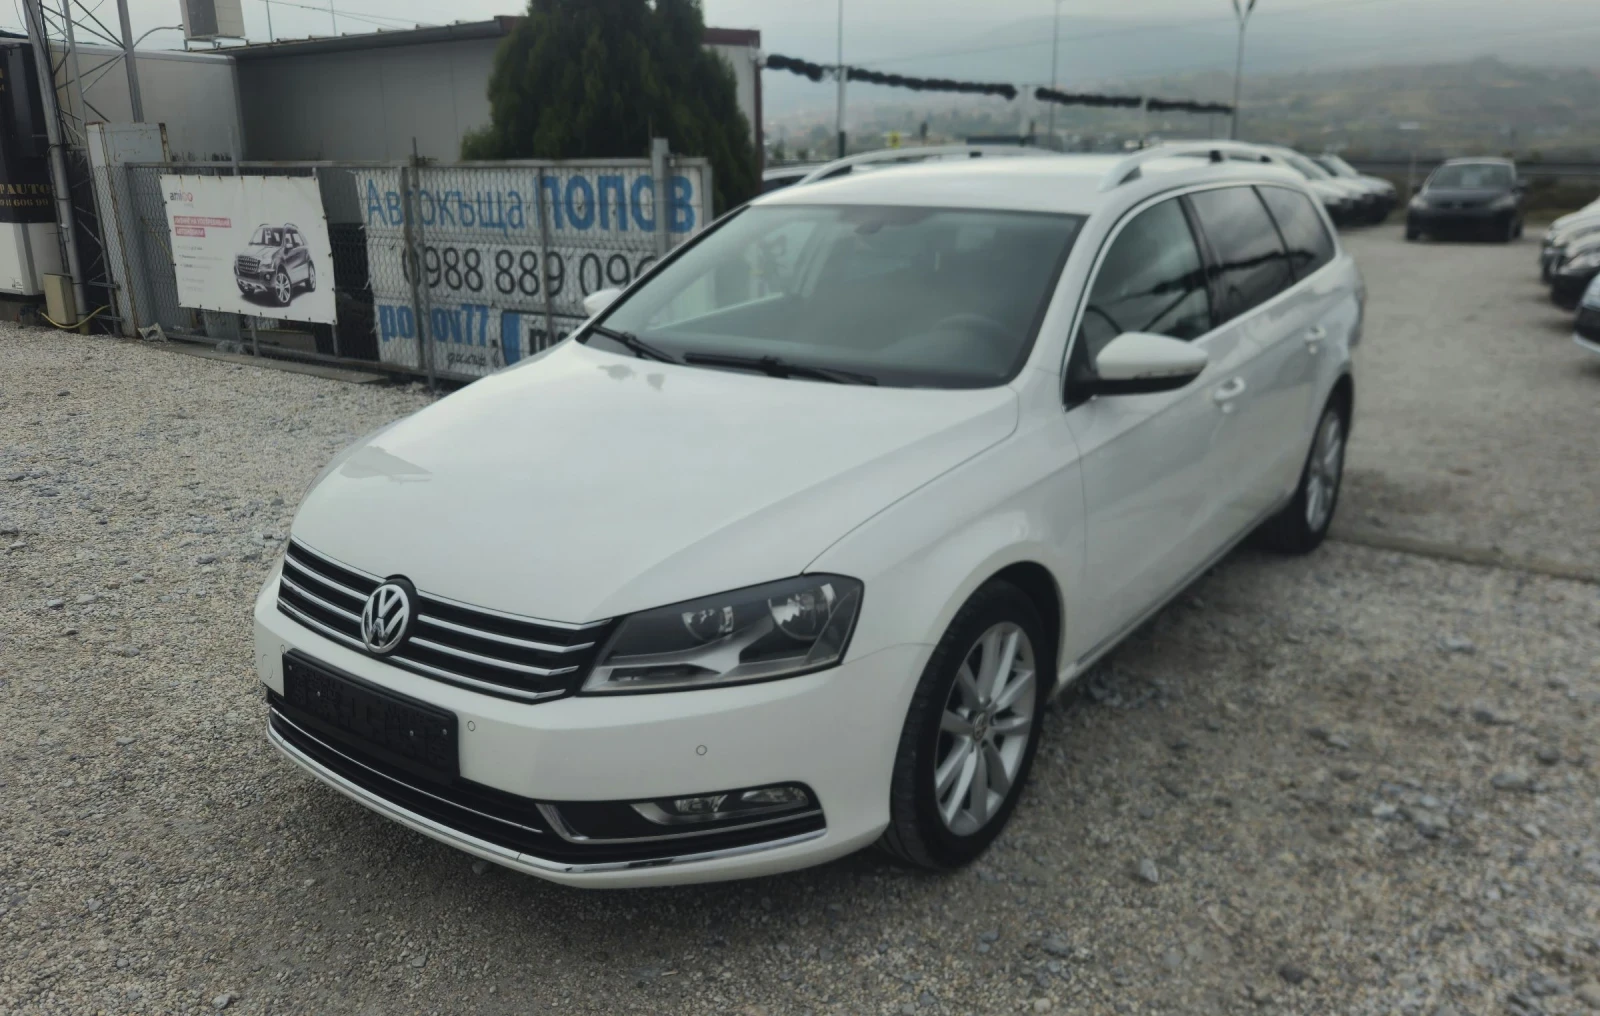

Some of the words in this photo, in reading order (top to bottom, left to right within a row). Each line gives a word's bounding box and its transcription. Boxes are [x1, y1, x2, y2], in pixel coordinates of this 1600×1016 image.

[401, 245, 484, 292] 0988
[495, 249, 565, 298] 889
[580, 253, 657, 298] 09
